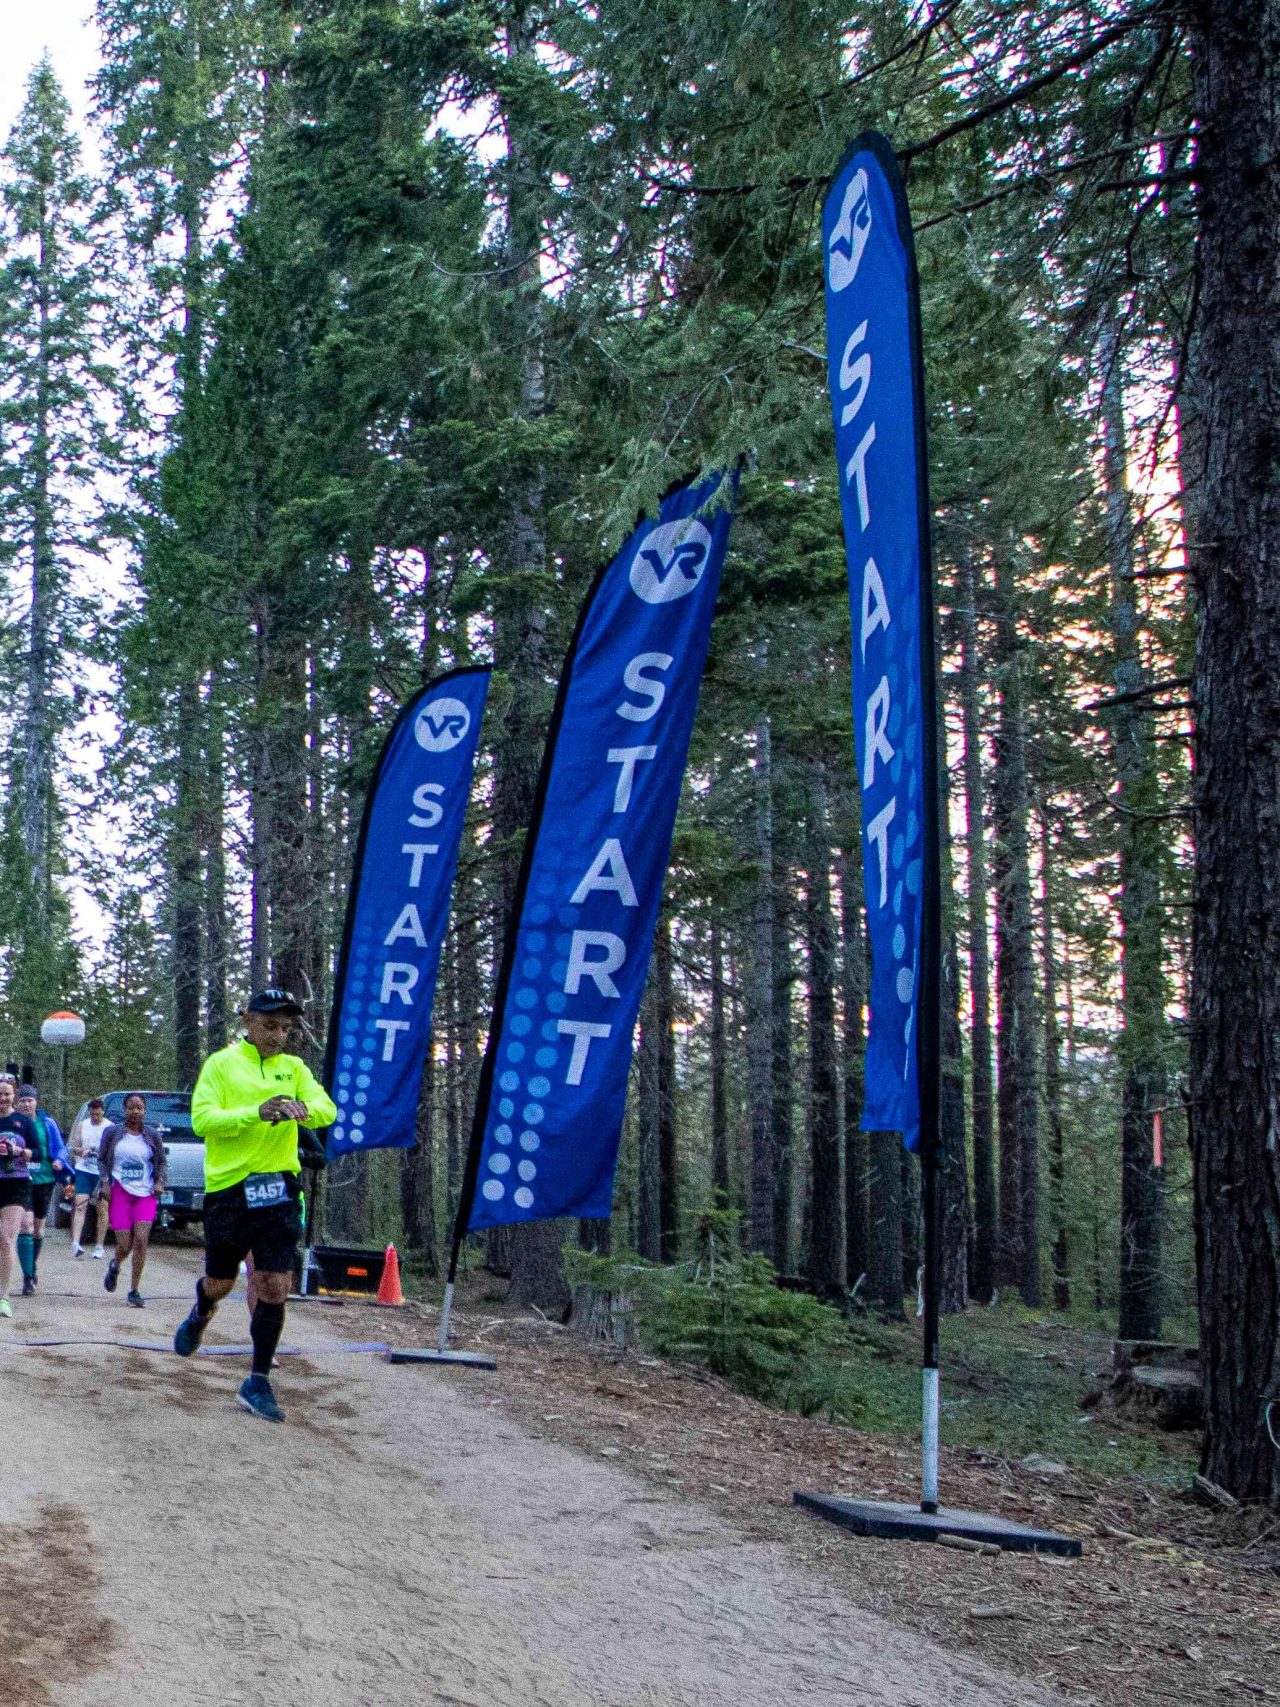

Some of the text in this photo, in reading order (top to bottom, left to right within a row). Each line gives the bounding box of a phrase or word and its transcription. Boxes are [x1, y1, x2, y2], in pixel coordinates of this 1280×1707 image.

[637, 541, 708, 583] VR
[837, 319, 897, 909] START
[421, 713, 467, 738] VR
[375, 782, 446, 1062] START
[557, 651, 674, 1087] START
[245, 1181, 286, 1201] 5457
